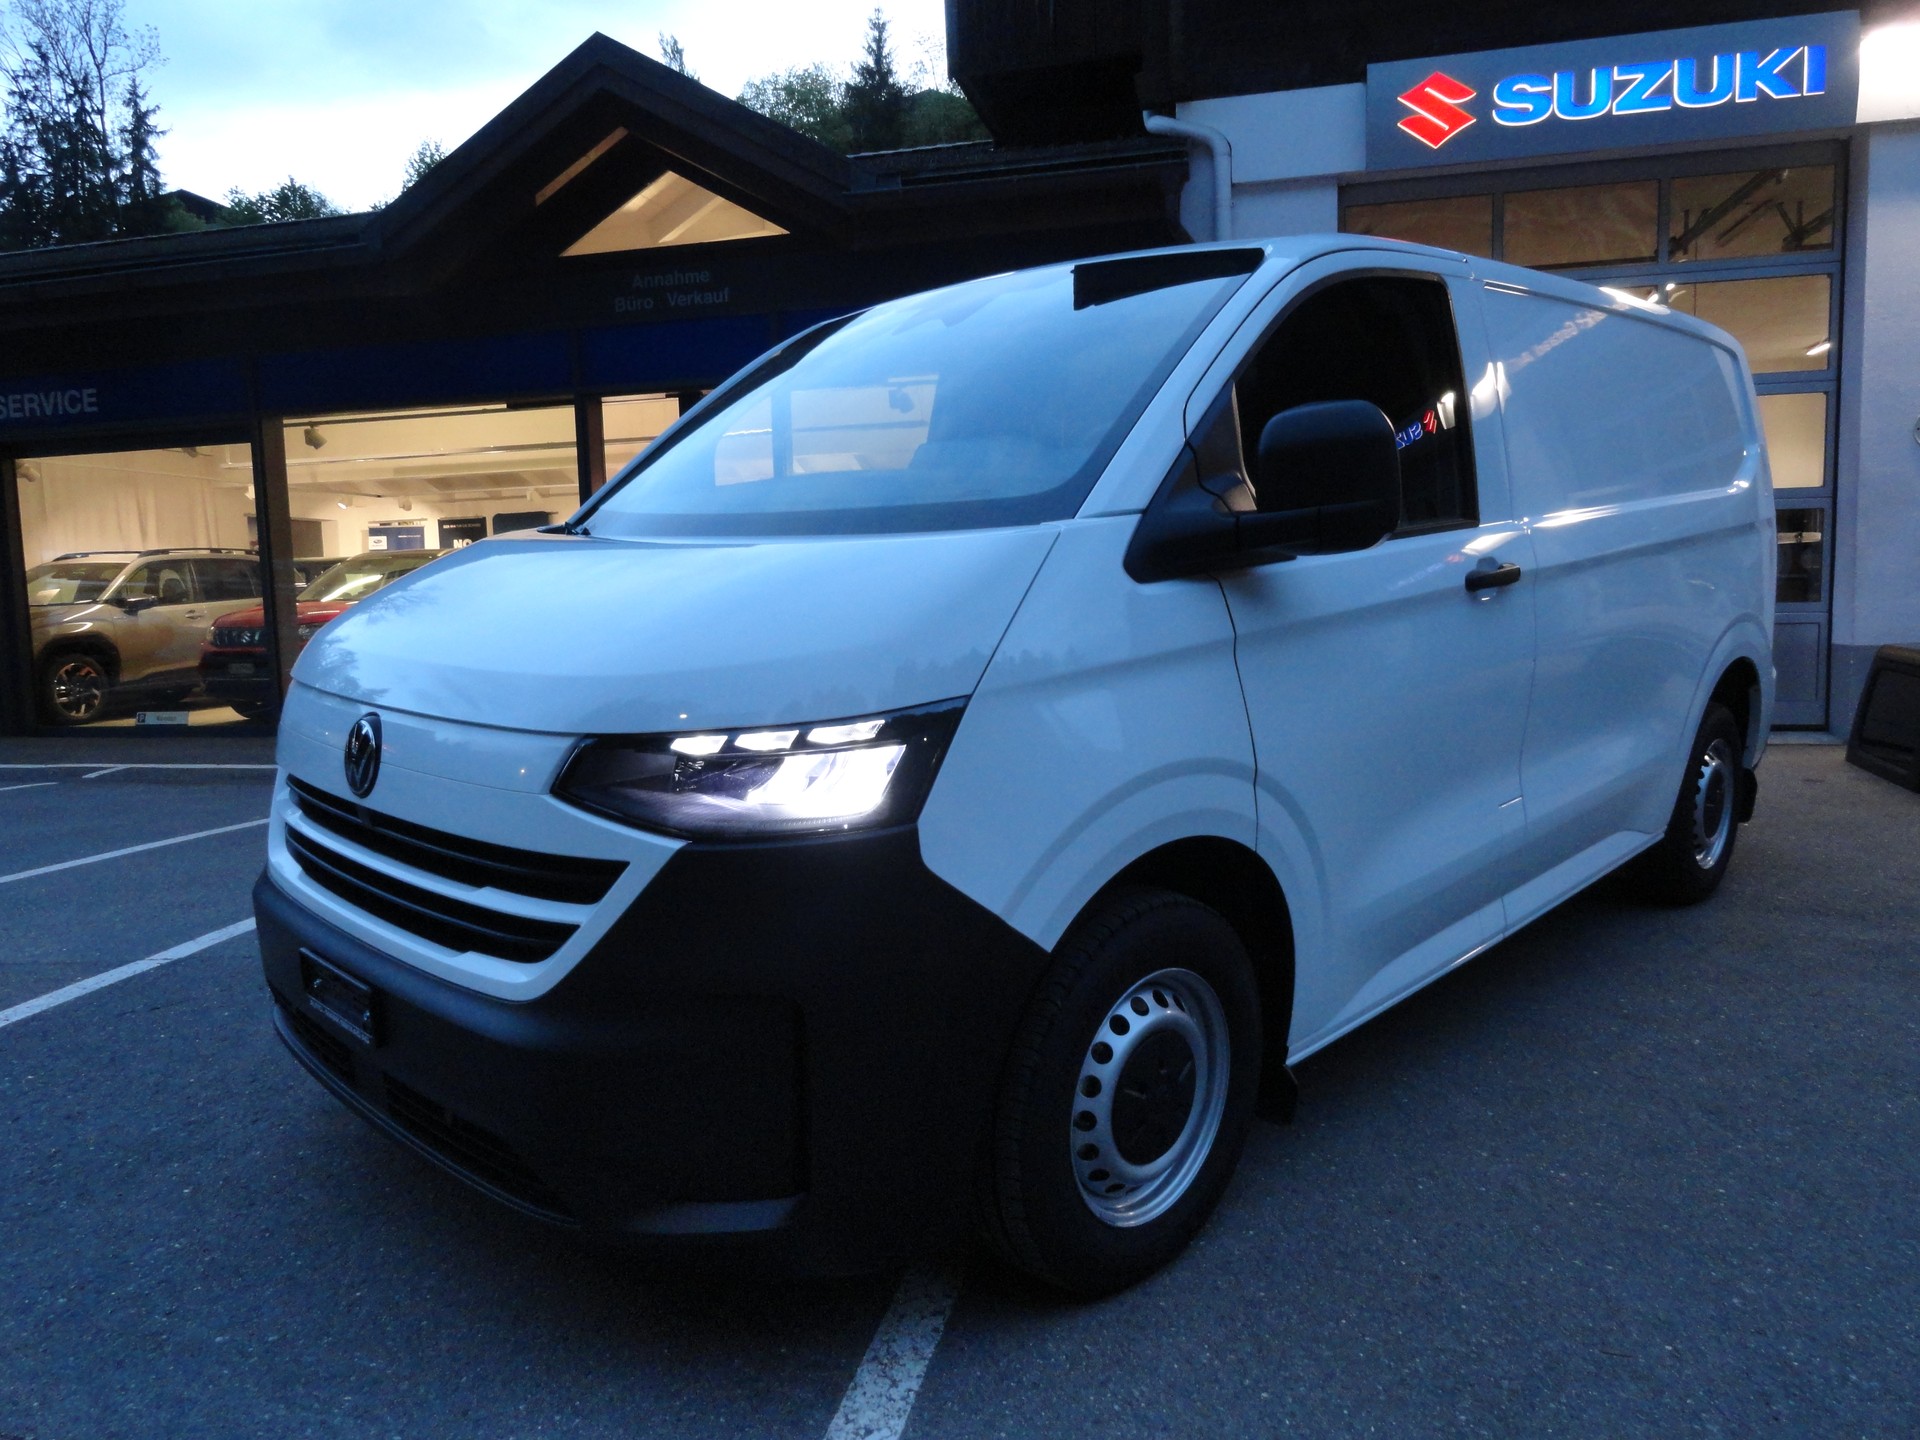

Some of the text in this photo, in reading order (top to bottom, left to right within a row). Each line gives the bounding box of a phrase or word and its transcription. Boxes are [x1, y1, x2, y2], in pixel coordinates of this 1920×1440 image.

[1493, 45, 1826, 127] SUZUKI
[632, 270, 710, 289] Annahme
[614, 286, 729, 313] Büro Verkauf
